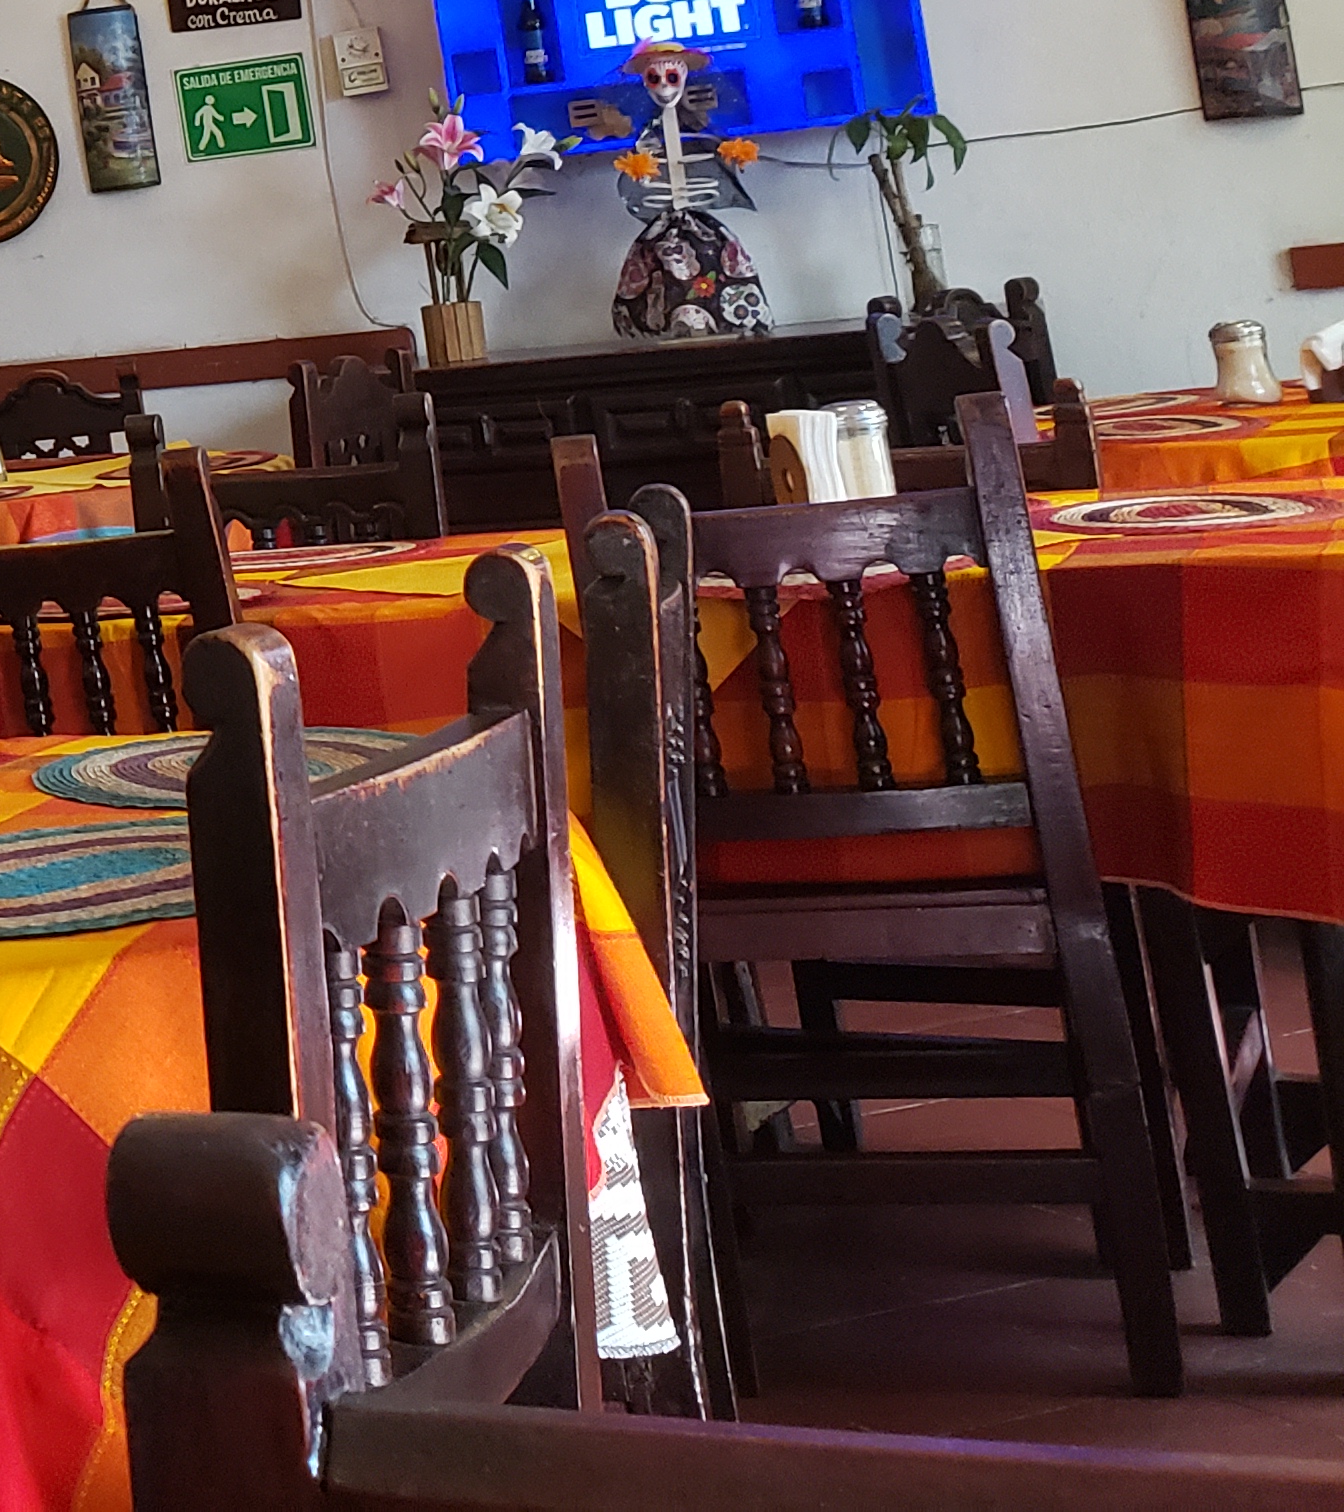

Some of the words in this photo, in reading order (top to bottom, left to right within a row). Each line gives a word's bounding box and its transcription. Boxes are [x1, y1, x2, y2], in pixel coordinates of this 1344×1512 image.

[187, 13, 216, 29] con
[216, 7, 278, 26] Crema
[182, 73, 218, 90] SALIDA
[219, 71, 233, 86] DE
[234, 62, 298, 83] EMERGENCIA
